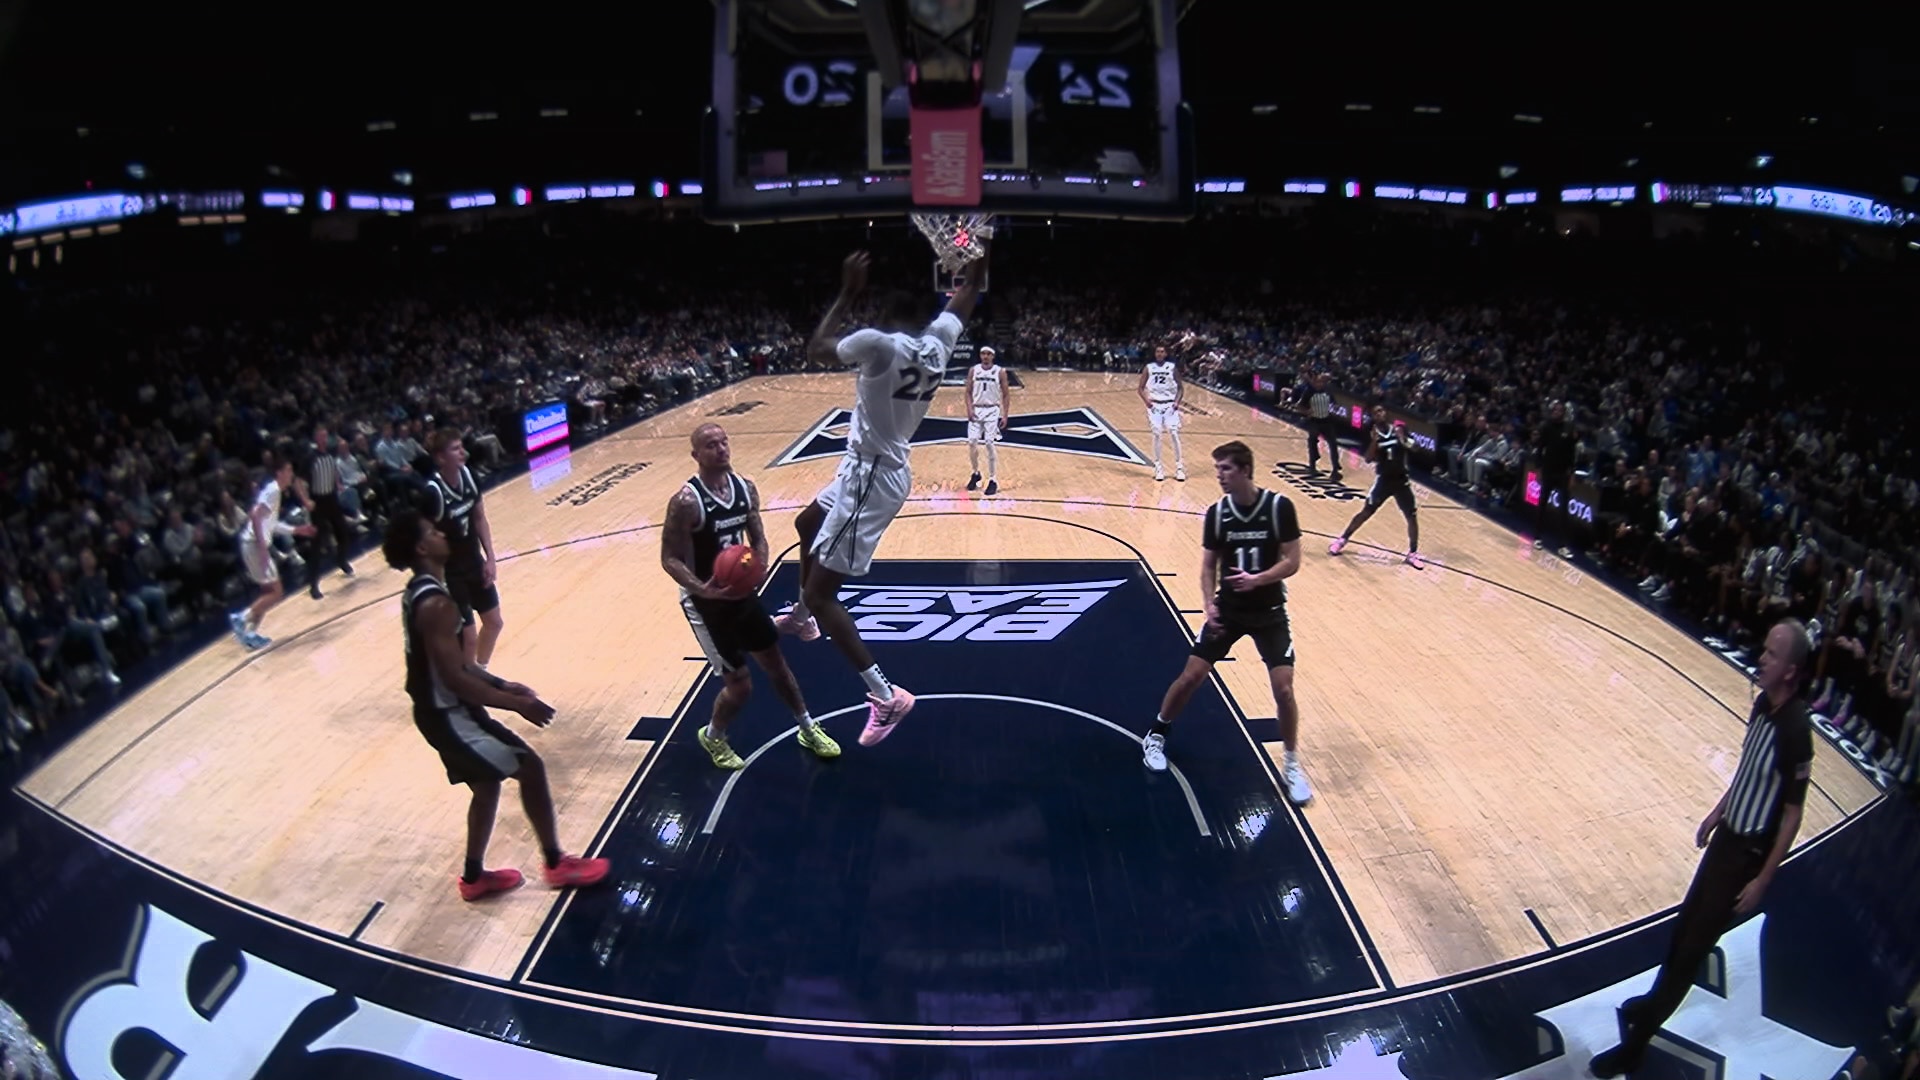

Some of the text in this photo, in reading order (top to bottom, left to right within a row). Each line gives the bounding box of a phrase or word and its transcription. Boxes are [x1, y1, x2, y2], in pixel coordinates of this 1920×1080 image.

[892, 366, 943, 401] 22
[1154, 376, 1166, 385] 12
[1234, 546, 1261, 572] 11
[827, 613, 1083, 641] BIG
